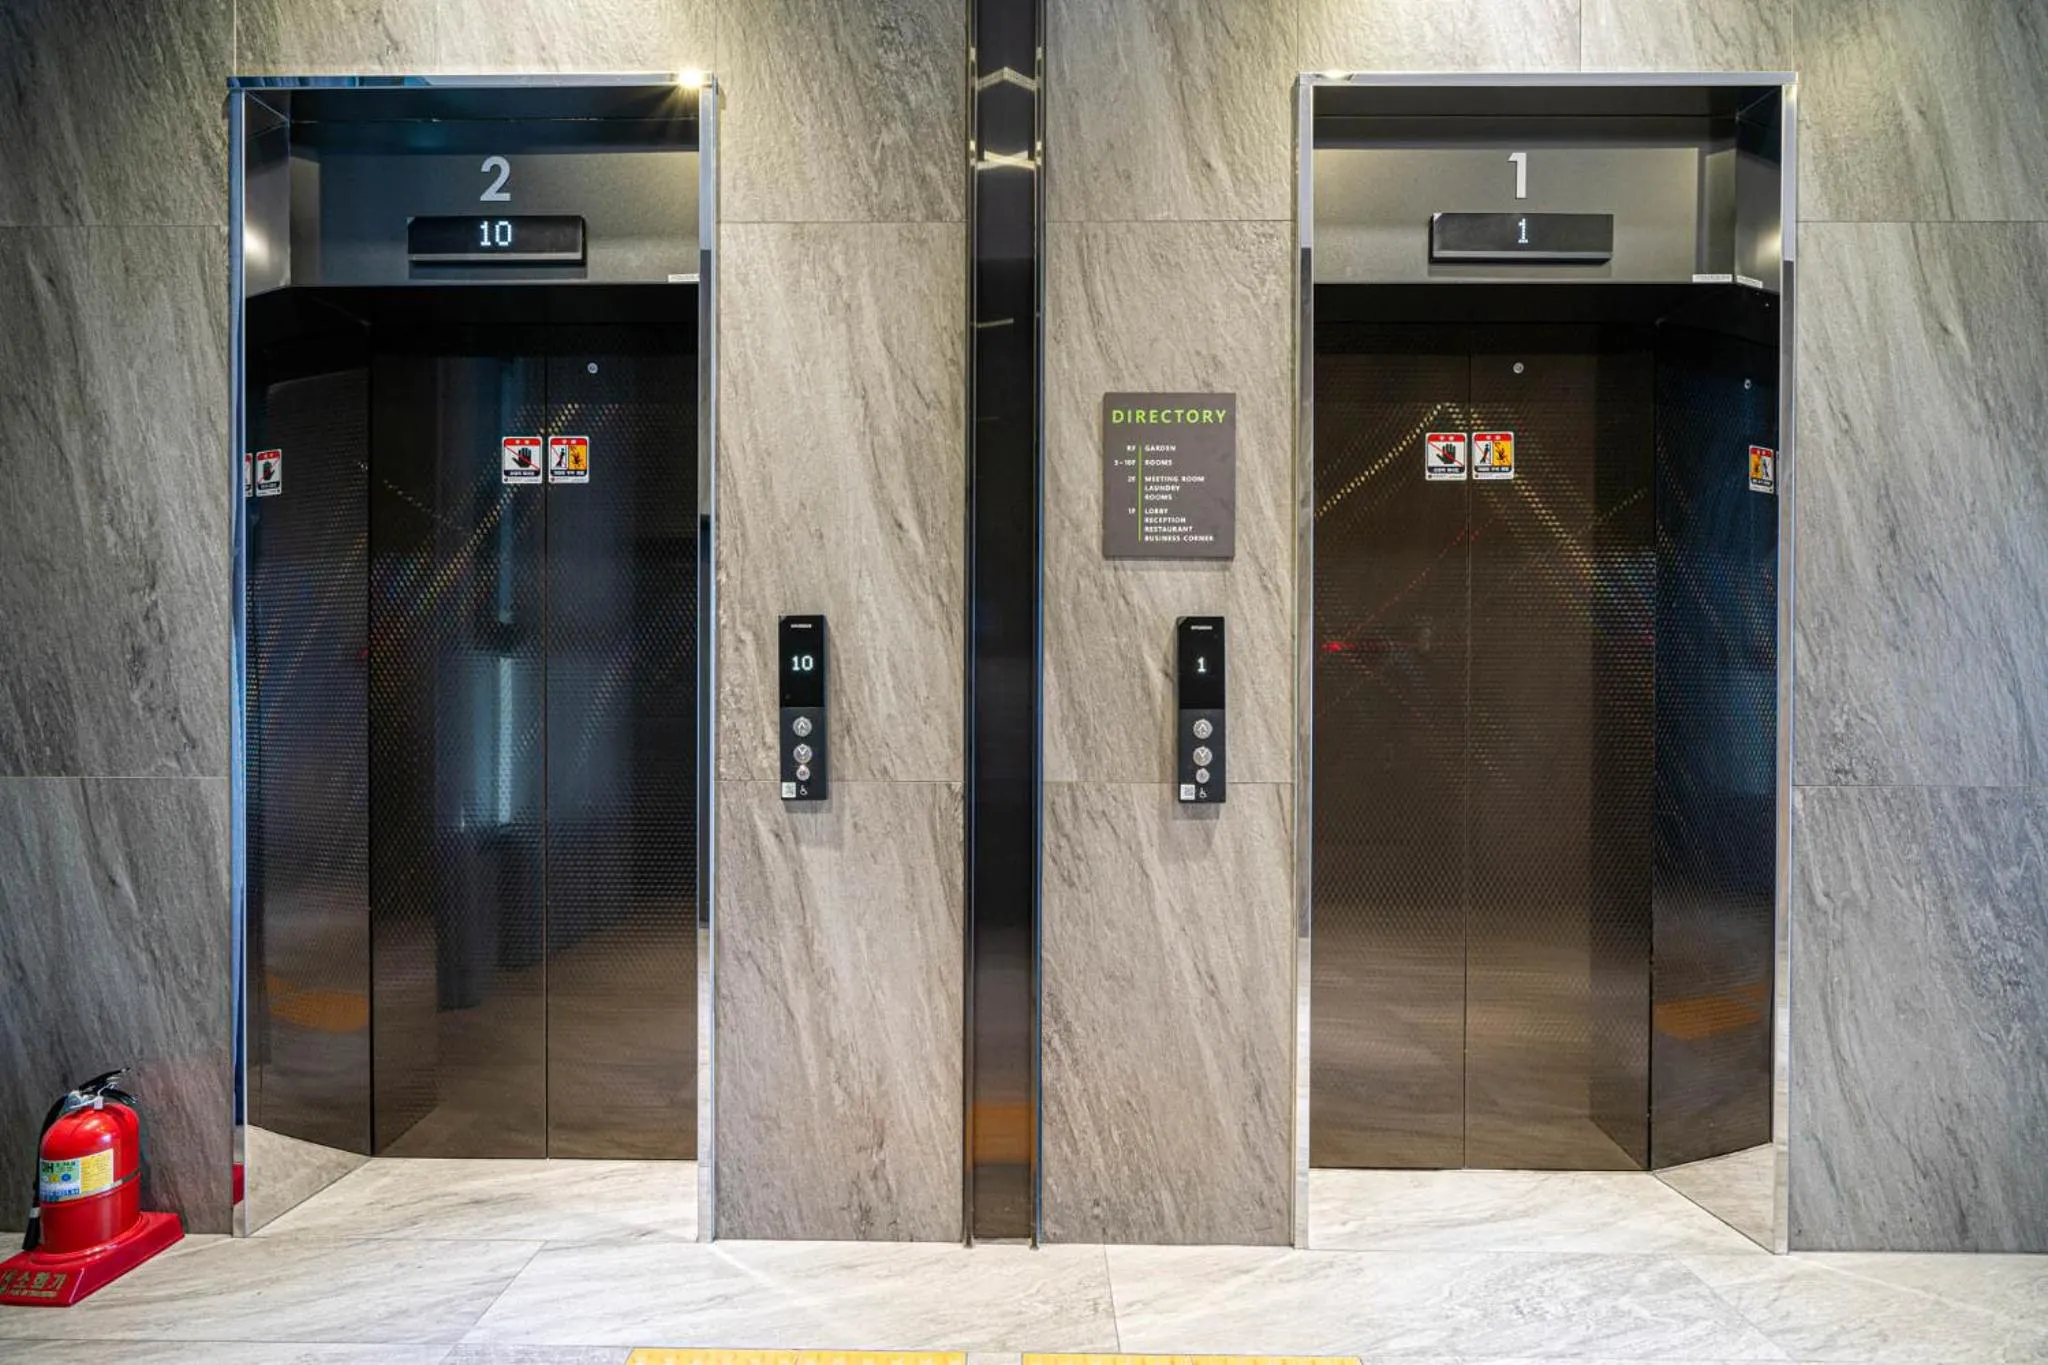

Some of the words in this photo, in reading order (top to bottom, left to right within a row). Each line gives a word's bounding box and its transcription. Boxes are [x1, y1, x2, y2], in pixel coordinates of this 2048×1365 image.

[480, 156, 511, 201] 2
[1507, 152, 1527, 198] 1
[480, 220, 512, 246] 10
[1517, 218, 1529, 244] 1
[1112, 410, 1226, 423] DIRECTORY
[1144, 444, 1177, 452] GARDEN
[1144, 459, 1173, 467] ROOMS
[1127, 475, 1136, 483] 2F
[1144, 475, 1179, 483] MEETING
[1181, 475, 1205, 483] ROOM
[1144, 493, 1173, 501] ROOMS
[1144, 507, 1169, 515] LOBBY
[1144, 516, 1186, 524] RECEPTION
[1144, 525, 1193, 533] RESTAURANT
[1144, 534, 1181, 542] BUSINESS
[1182, 534, 1214, 542] CORNER
[792, 655, 813, 671] 10
[1197, 656, 1206, 672] 1
